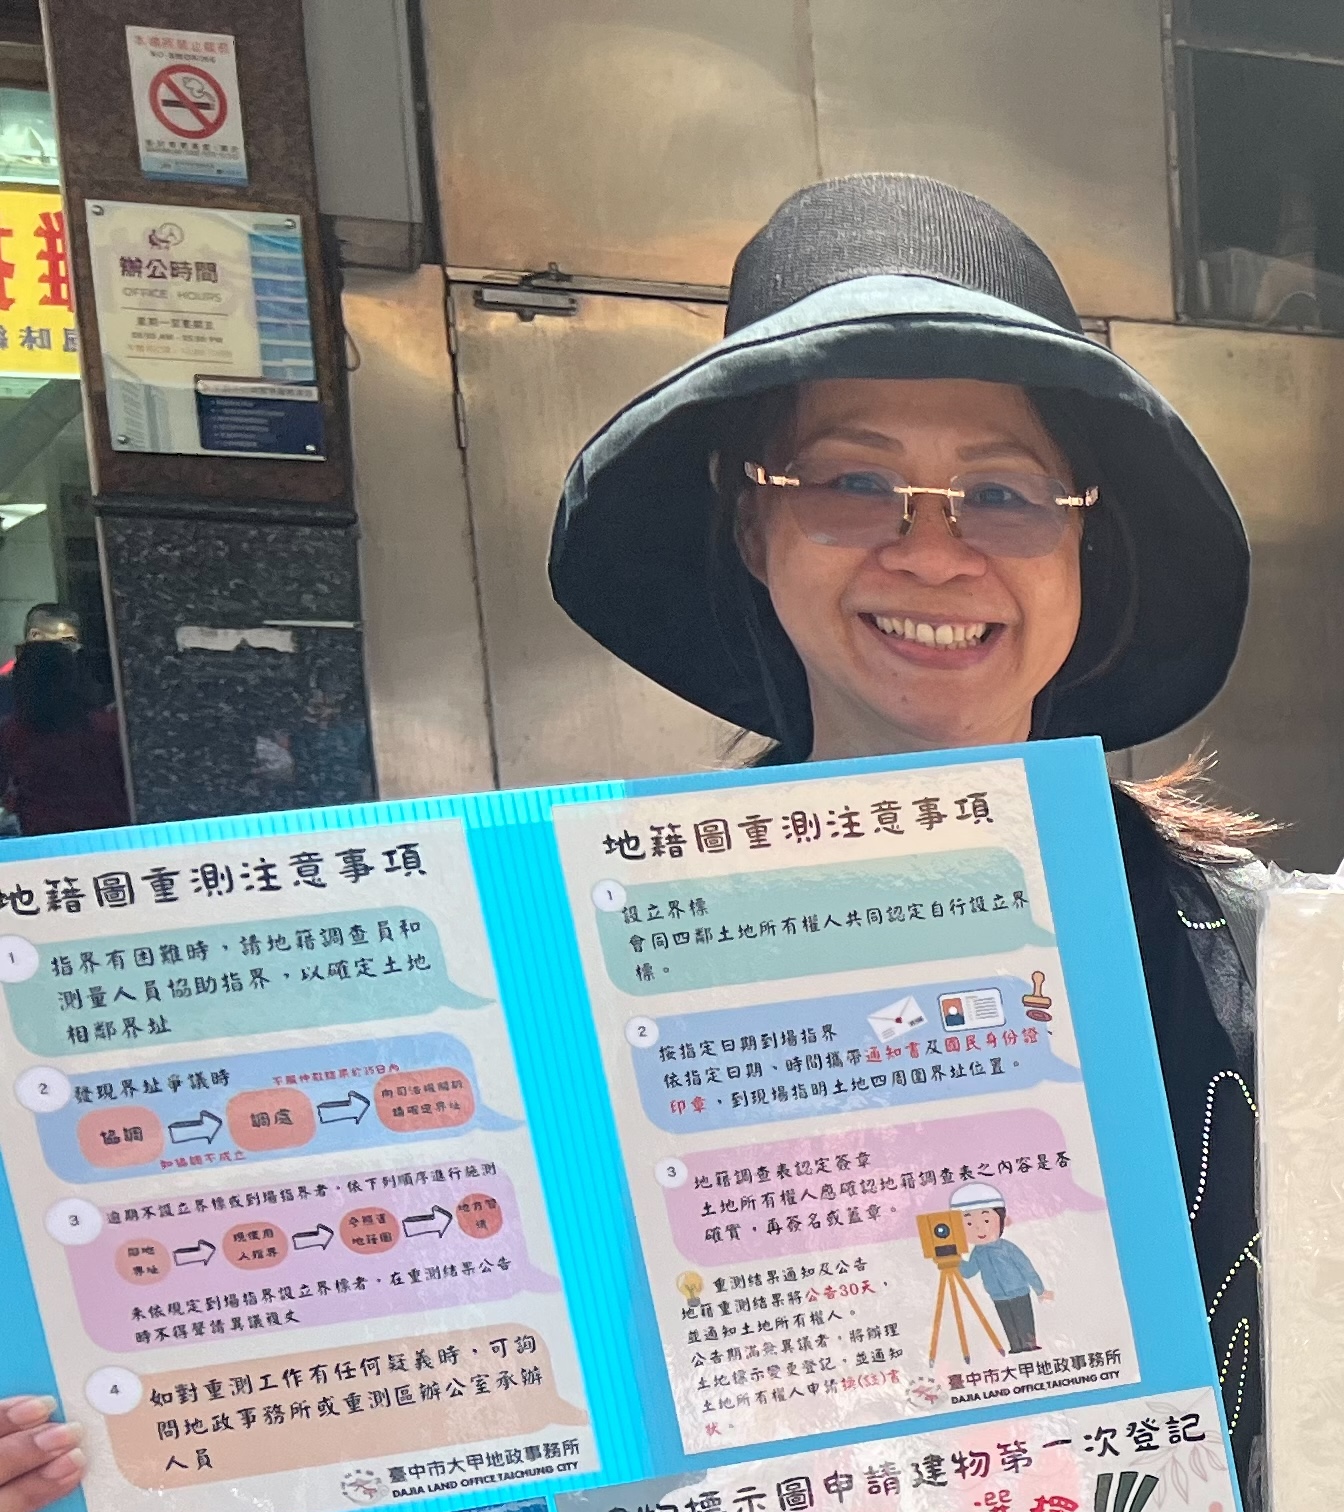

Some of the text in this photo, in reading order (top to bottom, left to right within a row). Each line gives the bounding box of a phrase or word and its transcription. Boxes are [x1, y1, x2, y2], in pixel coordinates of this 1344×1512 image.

[119, 256, 219, 284] 辦公時間
[122, 287, 222, 302] OFFICE HOURS
[599, 789, 995, 865] 地籍圖重測注意事項
[0, 840, 429, 920] 地籍圖重測注意事項
[621, 897, 709, 924] 設立界標
[626, 889, 1031, 953] 會同四鄰土地所有權人共同認定自行設立界
[64, 1014, 172, 1046] 相鄰界址
[657, 1023, 839, 1062] 按指定日期到場指界
[71, 1067, 233, 1104] 發現界址爭議時
[99, 1125, 145, 1147] 協調
[249, 1107, 293, 1129] 調處
[691, 1150, 873, 1191] 地籍調查表認定簽章
[698, 1151, 1072, 1218] 土地所有權人應確認地籍調查表之內容是否
[710, 1255, 870, 1293] 重測結果通知及公告
[945, 1347, 1123, 1390] 臺中市大甲地政事務所
[982, 1387, 1010, 1400] LAND
[1099, 1369, 1121, 1381] CITY
[154, 1363, 544, 1443] 問地政事務所或重測區辦公室承辦
[160, 1447, 215, 1475] 人員
[385, 1436, 581, 1485] 臺中市大甲地政事務所
[428, 1480, 456, 1493] LAND
[556, 1459, 579, 1472] CITY
